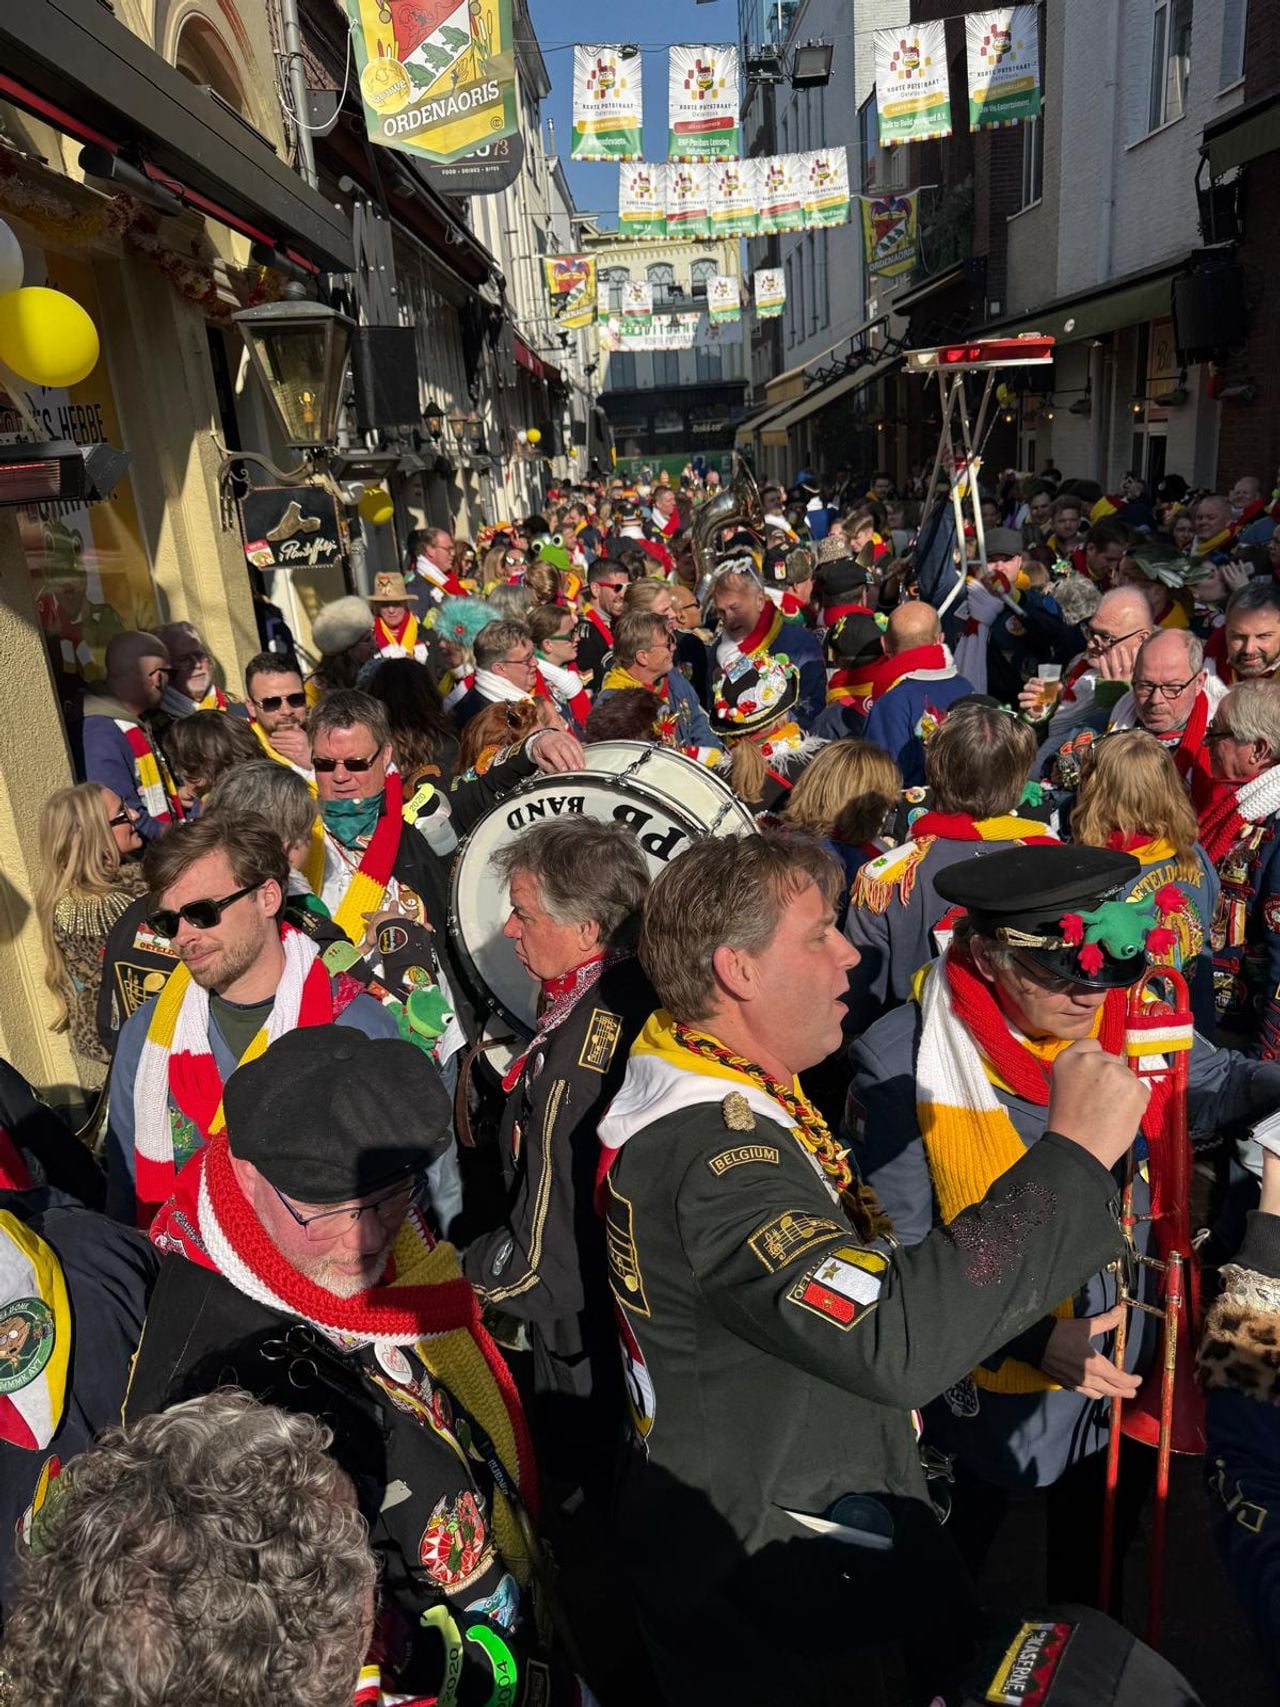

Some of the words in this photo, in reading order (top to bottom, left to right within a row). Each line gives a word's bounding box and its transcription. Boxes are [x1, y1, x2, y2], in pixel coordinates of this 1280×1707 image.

[383, 80, 500, 137] ORDENAORIS
[58, 403, 108, 445] HEBBE
[507, 796, 585, 830] BAND
[715, 1148, 775, 1170] BELGIUM
